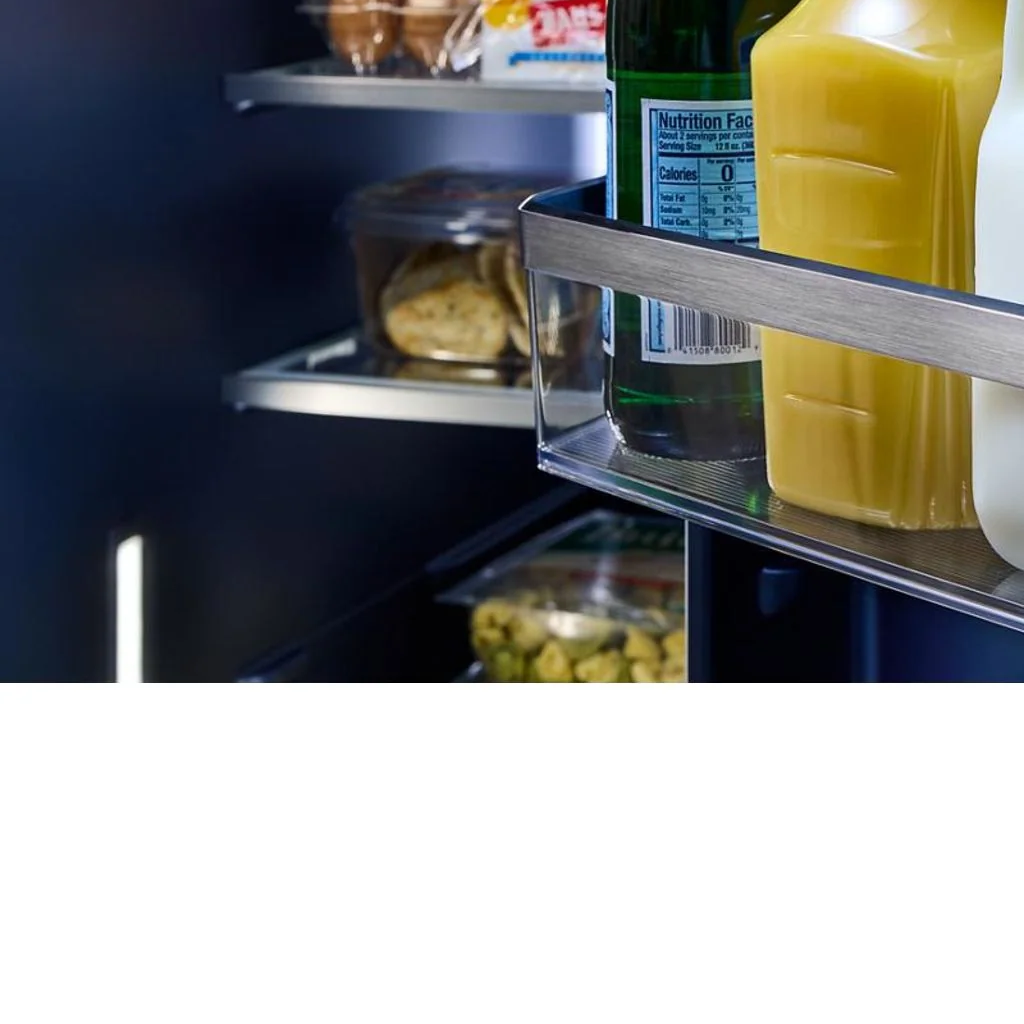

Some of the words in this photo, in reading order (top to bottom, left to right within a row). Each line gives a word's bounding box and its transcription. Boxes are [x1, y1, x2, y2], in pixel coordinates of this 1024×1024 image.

[659, 112, 722, 129] Nutrition
[727, 112, 753, 128] Fac
[659, 131, 678, 139] About
[680, 131, 684, 139] 2
[686, 131, 717, 142] servings
[719, 132, 731, 141] per
[733, 131, 754, 139] conta
[659, 141, 685, 152] Serving
[686, 141, 702, 150] Size
[715, 142, 724, 150] 12
[660, 165, 697, 181] Calories
[721, 164, 733, 182] 0
[661, 194, 673, 202] Total
[660, 206, 682, 214] Sodium
